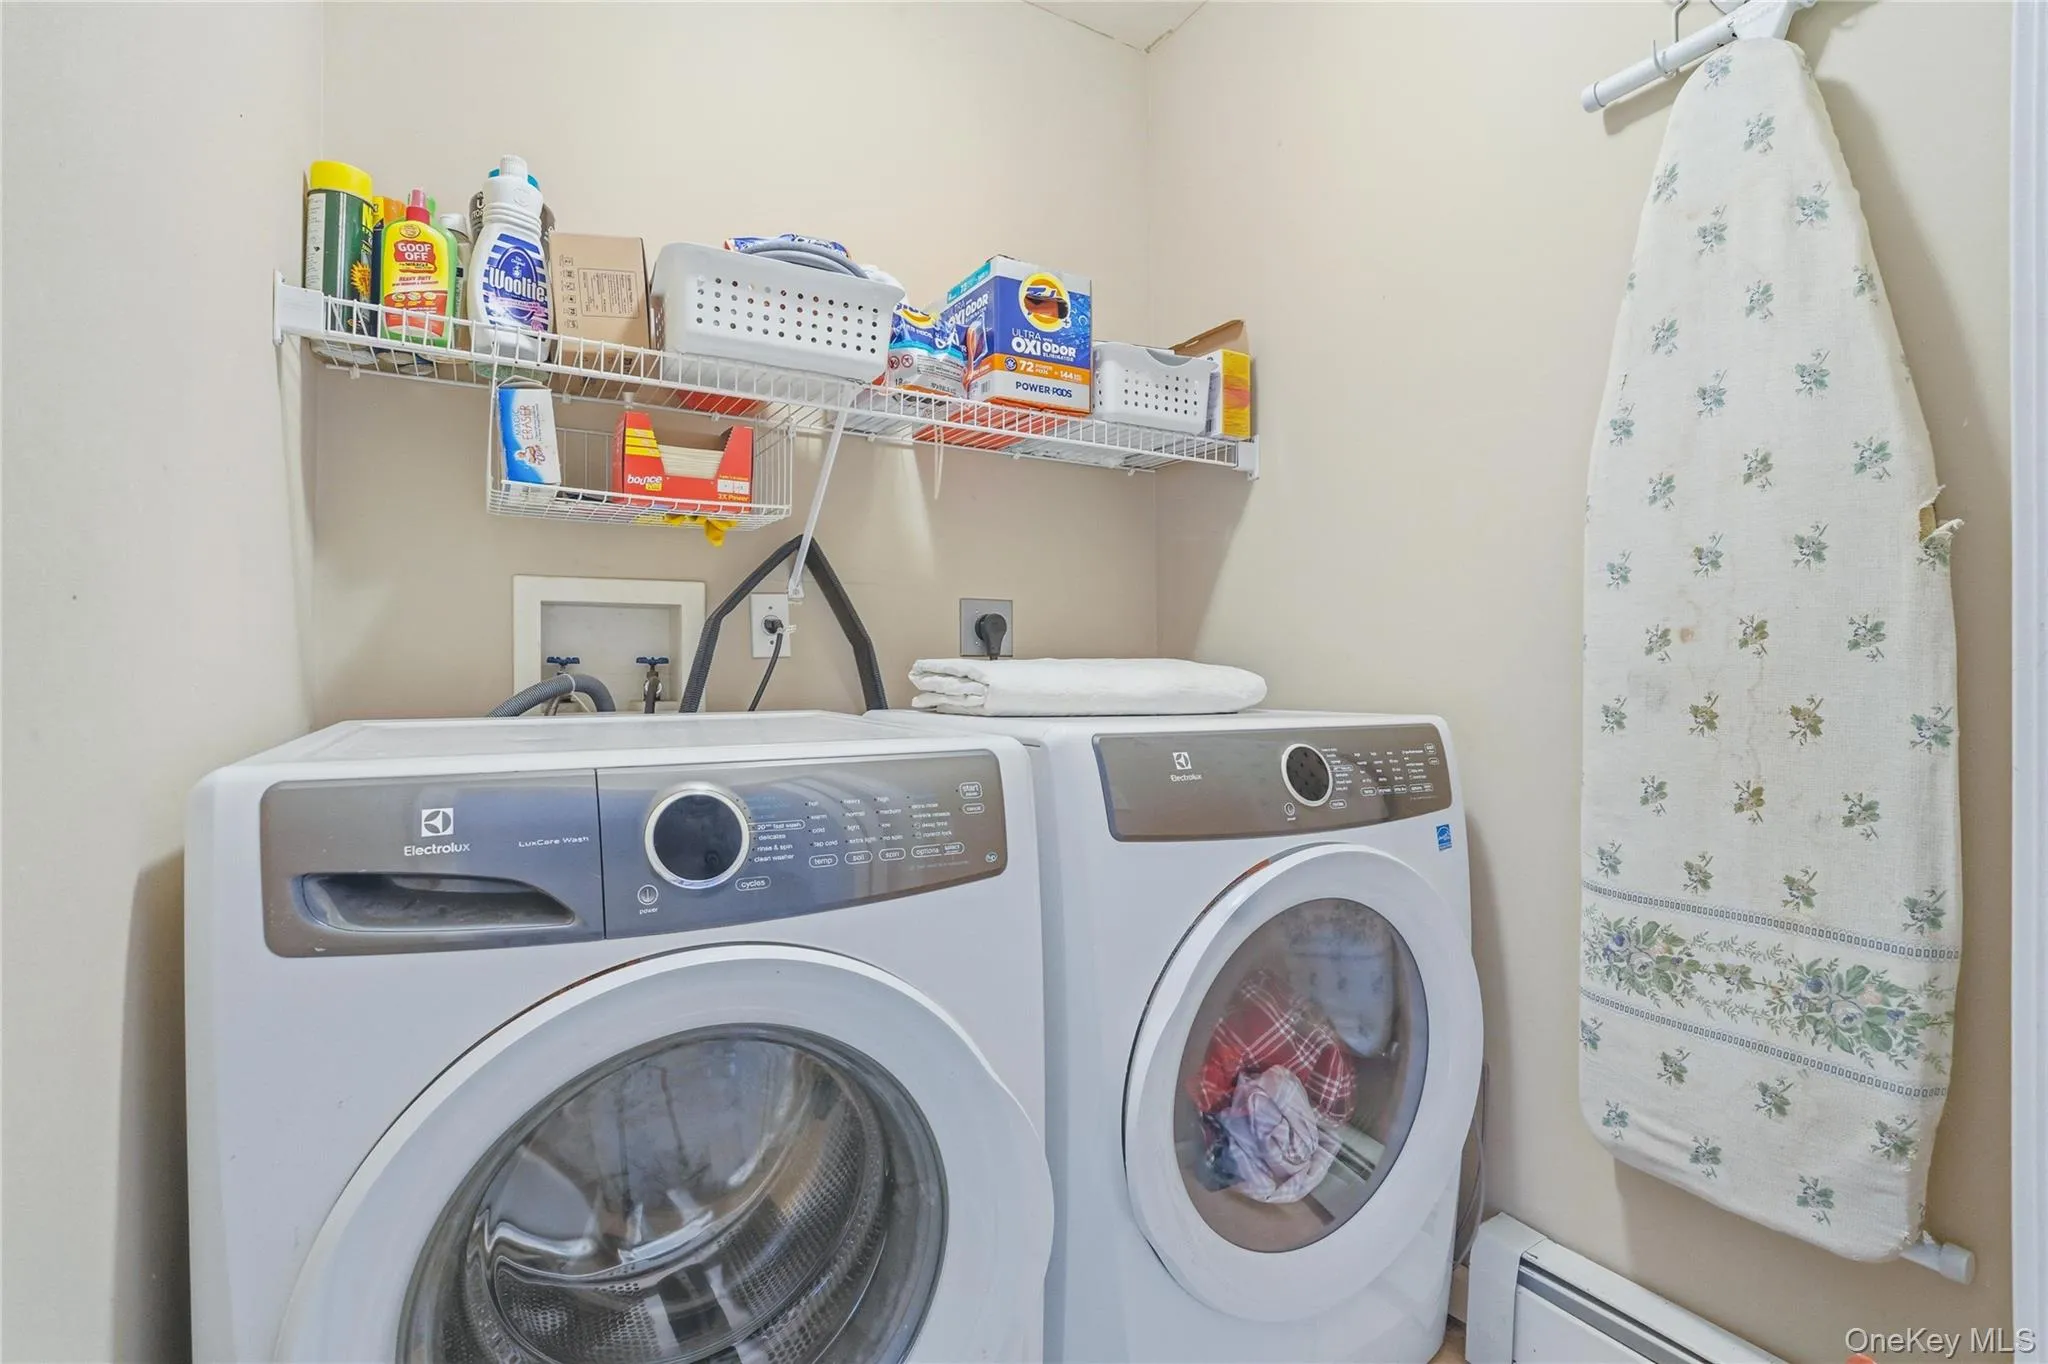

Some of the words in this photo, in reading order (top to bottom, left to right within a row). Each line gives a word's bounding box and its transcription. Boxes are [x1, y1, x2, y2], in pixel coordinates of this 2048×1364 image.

[397, 243, 432, 252] GOOF
[404, 252, 428, 261] OFF
[488, 266, 546, 303] Woolite
[965, 293, 989, 317] ODOR
[1011, 327, 1042, 342] ULTRA
[1011, 335, 1041, 356] OXI
[1042, 341, 1077, 359] ODOR
[1019, 360, 1035, 373] 72
[1015, 380, 1054, 396] POWER
[1051, 386, 1074, 399] PODS
[519, 404, 534, 441] ERASER
[626, 474, 663, 486] bounce
[1170, 773, 1202, 783] Electrolux
[518, 837, 560, 848] LuxCare
[562, 835, 589, 845] Wash
[404, 841, 470, 857] Electrolux
[915, 846, 940, 856] options
[814, 855, 833, 866] temp
[852, 853, 866, 862] soil
[740, 879, 766, 890] cycles
[639, 906, 659, 915] power
